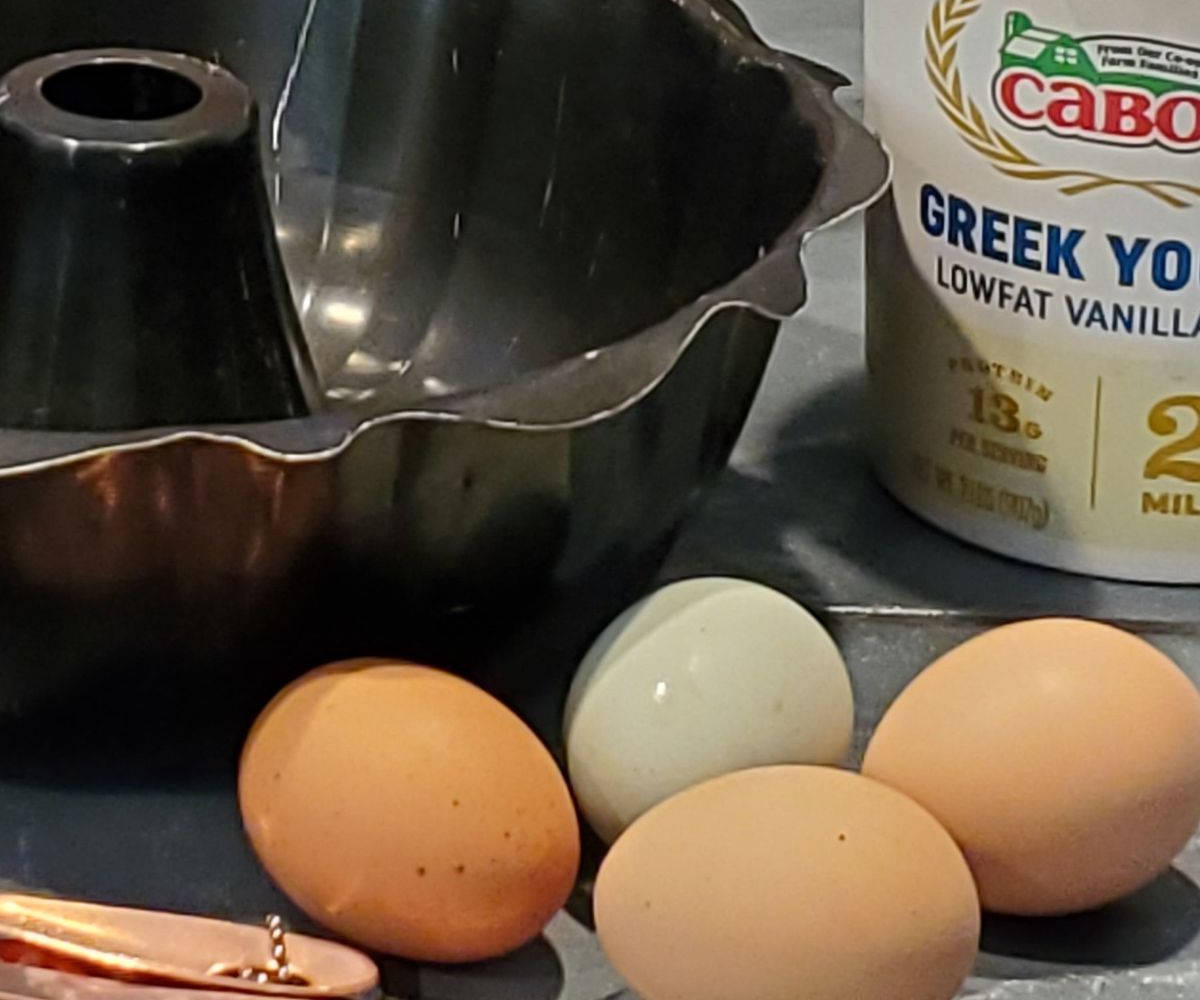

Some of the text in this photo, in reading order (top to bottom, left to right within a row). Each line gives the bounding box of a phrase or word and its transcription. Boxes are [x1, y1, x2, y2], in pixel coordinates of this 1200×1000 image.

[1102, 57, 1136, 67] Farm
[920, 183, 1200, 291] GREEK YO
[937, 255, 1053, 320] LOWFAT
